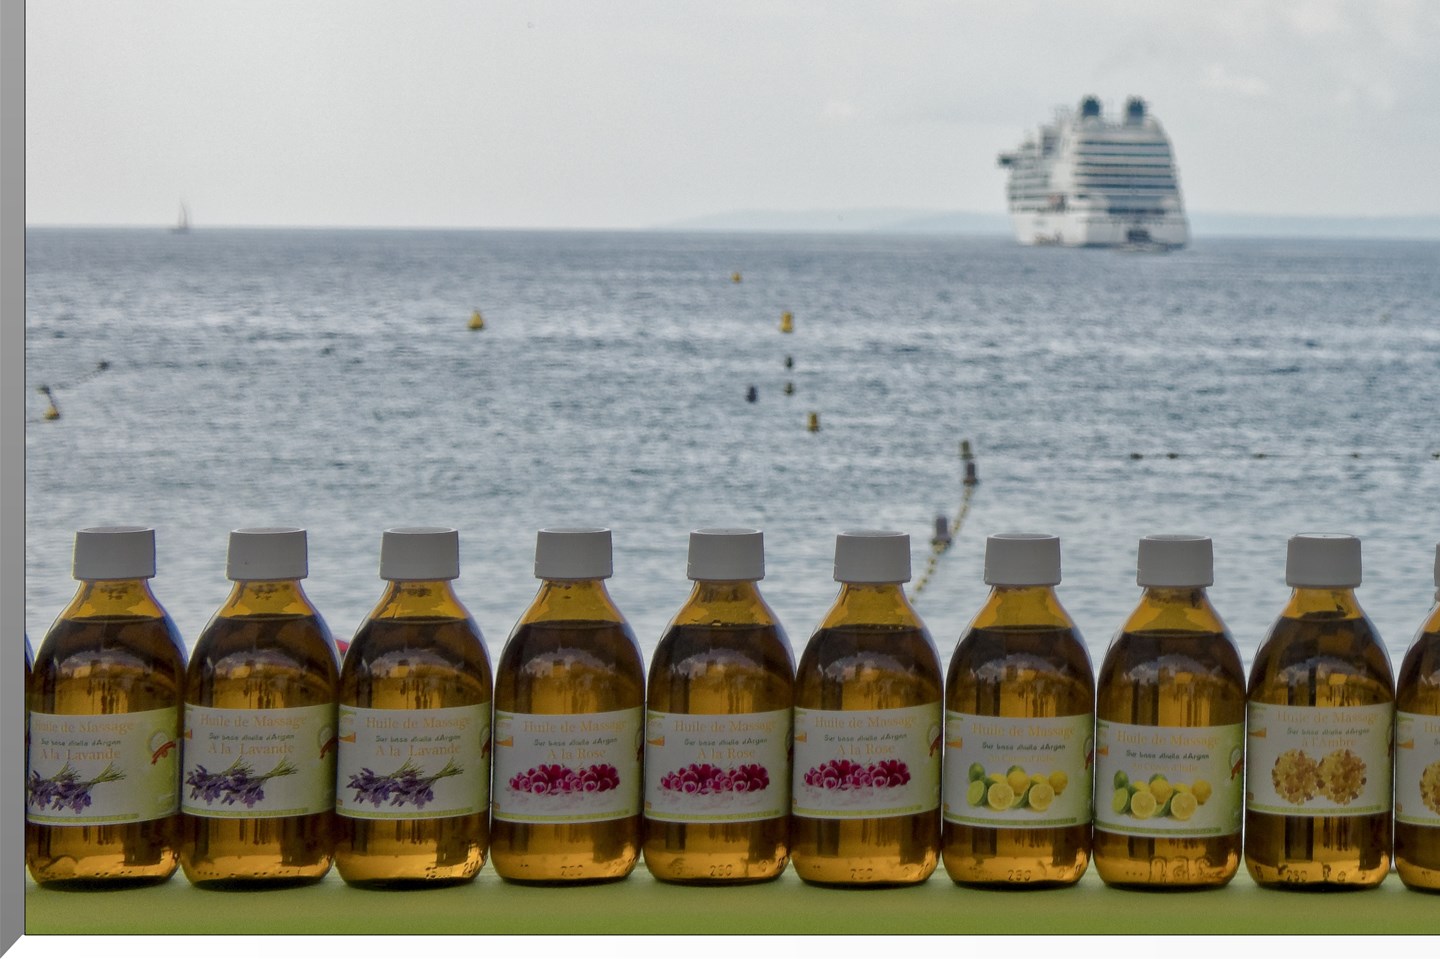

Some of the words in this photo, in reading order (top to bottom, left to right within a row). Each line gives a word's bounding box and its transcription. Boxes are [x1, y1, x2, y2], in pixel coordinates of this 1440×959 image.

[234, 716, 249, 727] de
[402, 718, 417, 728] de
[849, 718, 863, 728] de
[1314, 712, 1328, 723] de
[61, 721, 75, 733] de
[560, 721, 575, 732] de
[711, 721, 725, 732] de
[1008, 725, 1023, 736] de
[1151, 734, 1165, 744] de
